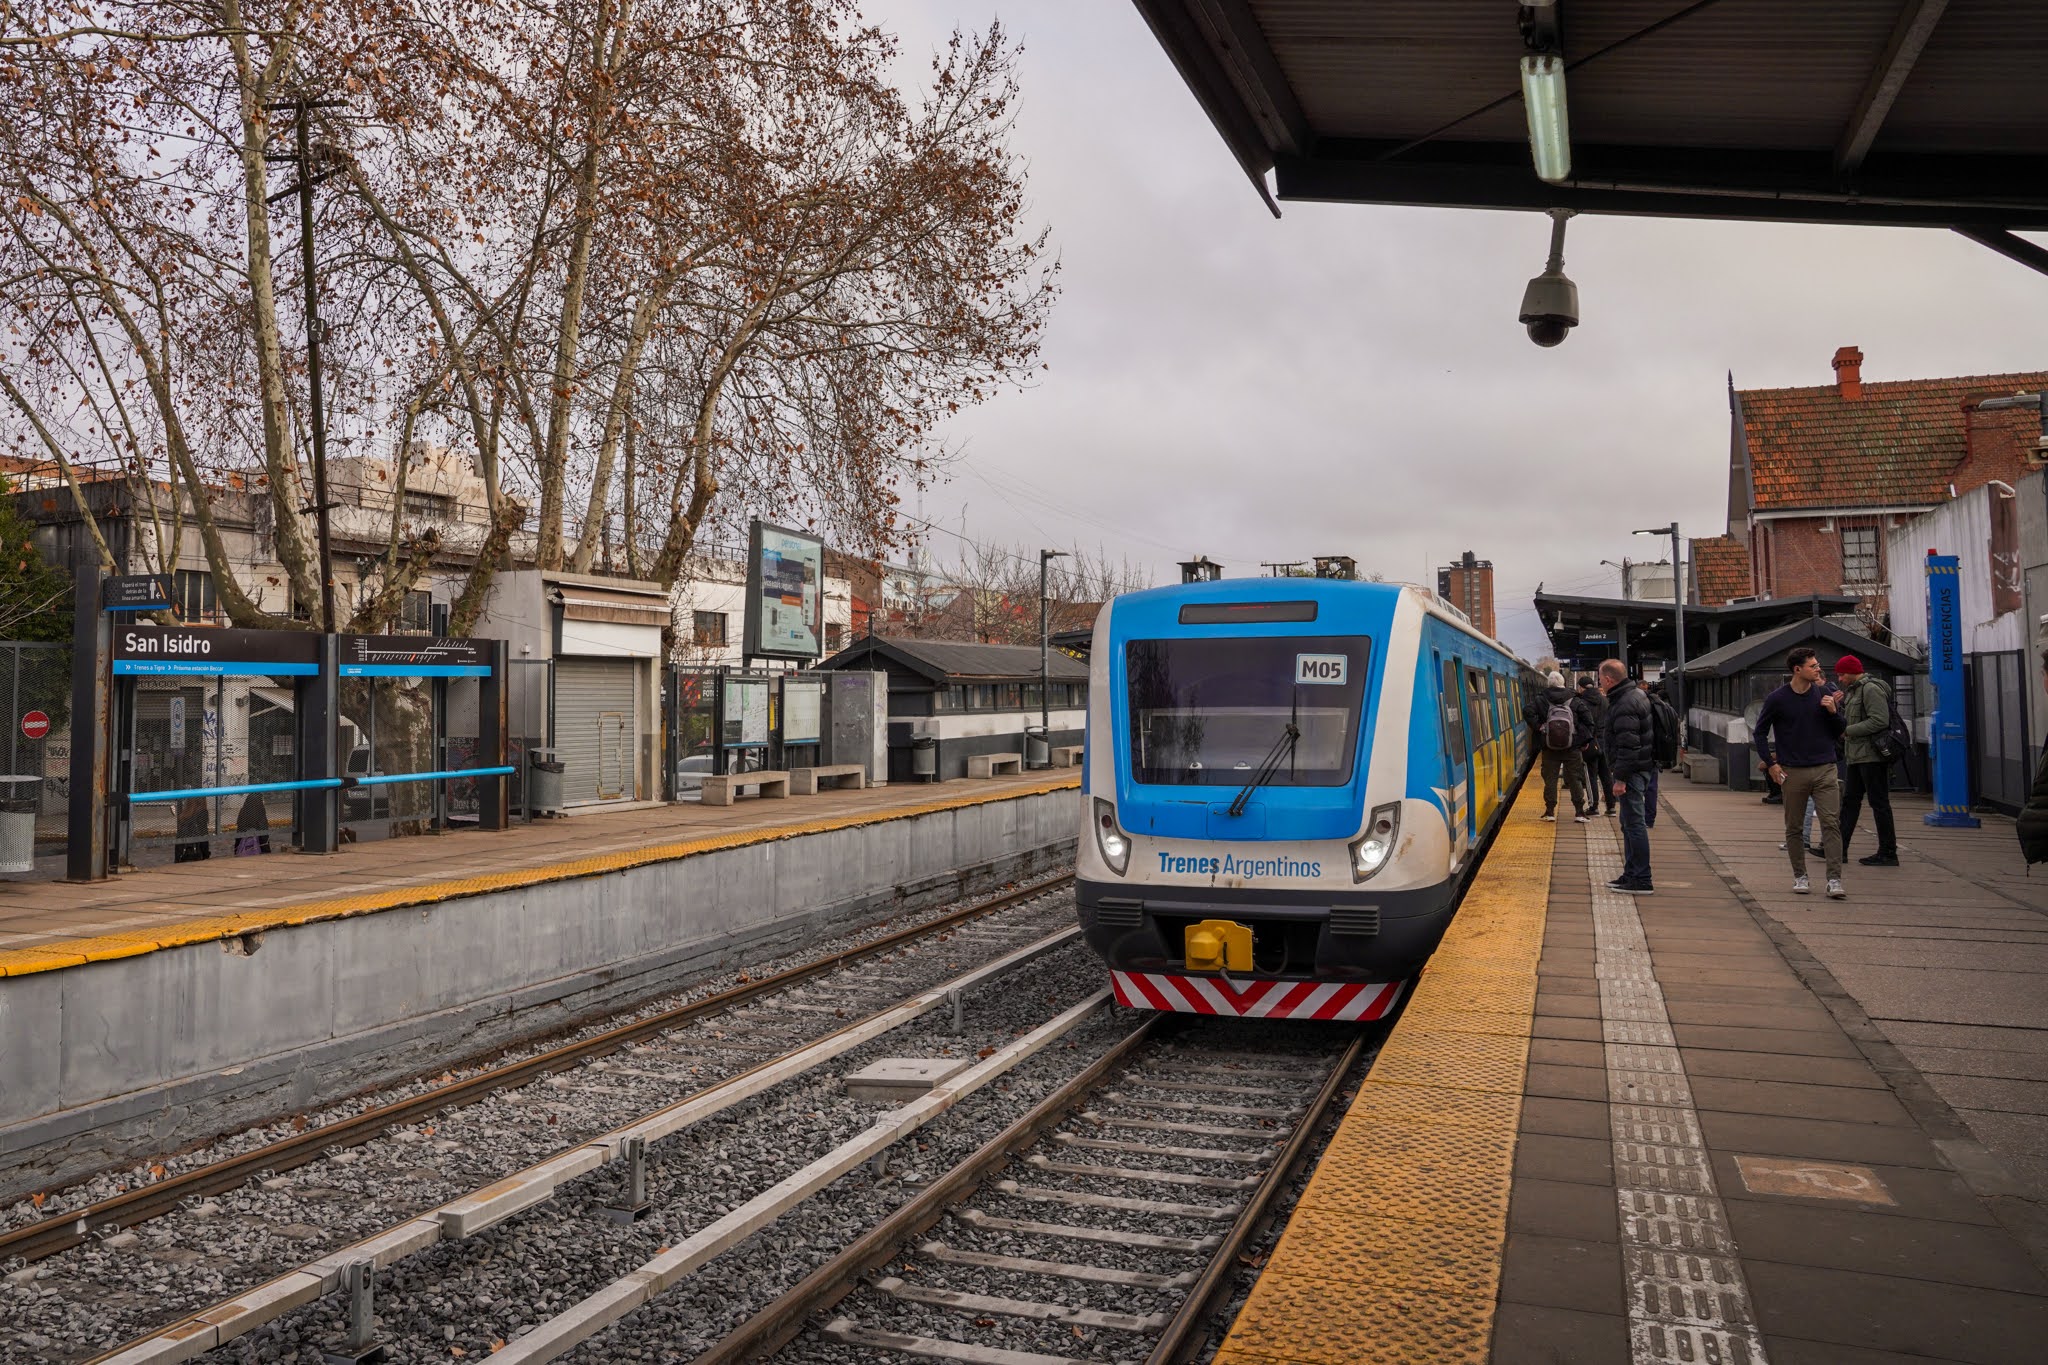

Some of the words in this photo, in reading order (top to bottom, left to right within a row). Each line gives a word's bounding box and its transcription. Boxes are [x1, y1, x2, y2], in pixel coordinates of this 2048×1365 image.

[1940, 588, 1953, 671] EMERGENCIAS
[125, 632, 158, 653] San
[163, 634, 211, 654] Isidro
[154, 664, 165, 672] Tigre
[1302, 660, 1341, 679] M05
[1158, 852, 1220, 874] Trenes
[1222, 853, 1321, 880] Argentinos
